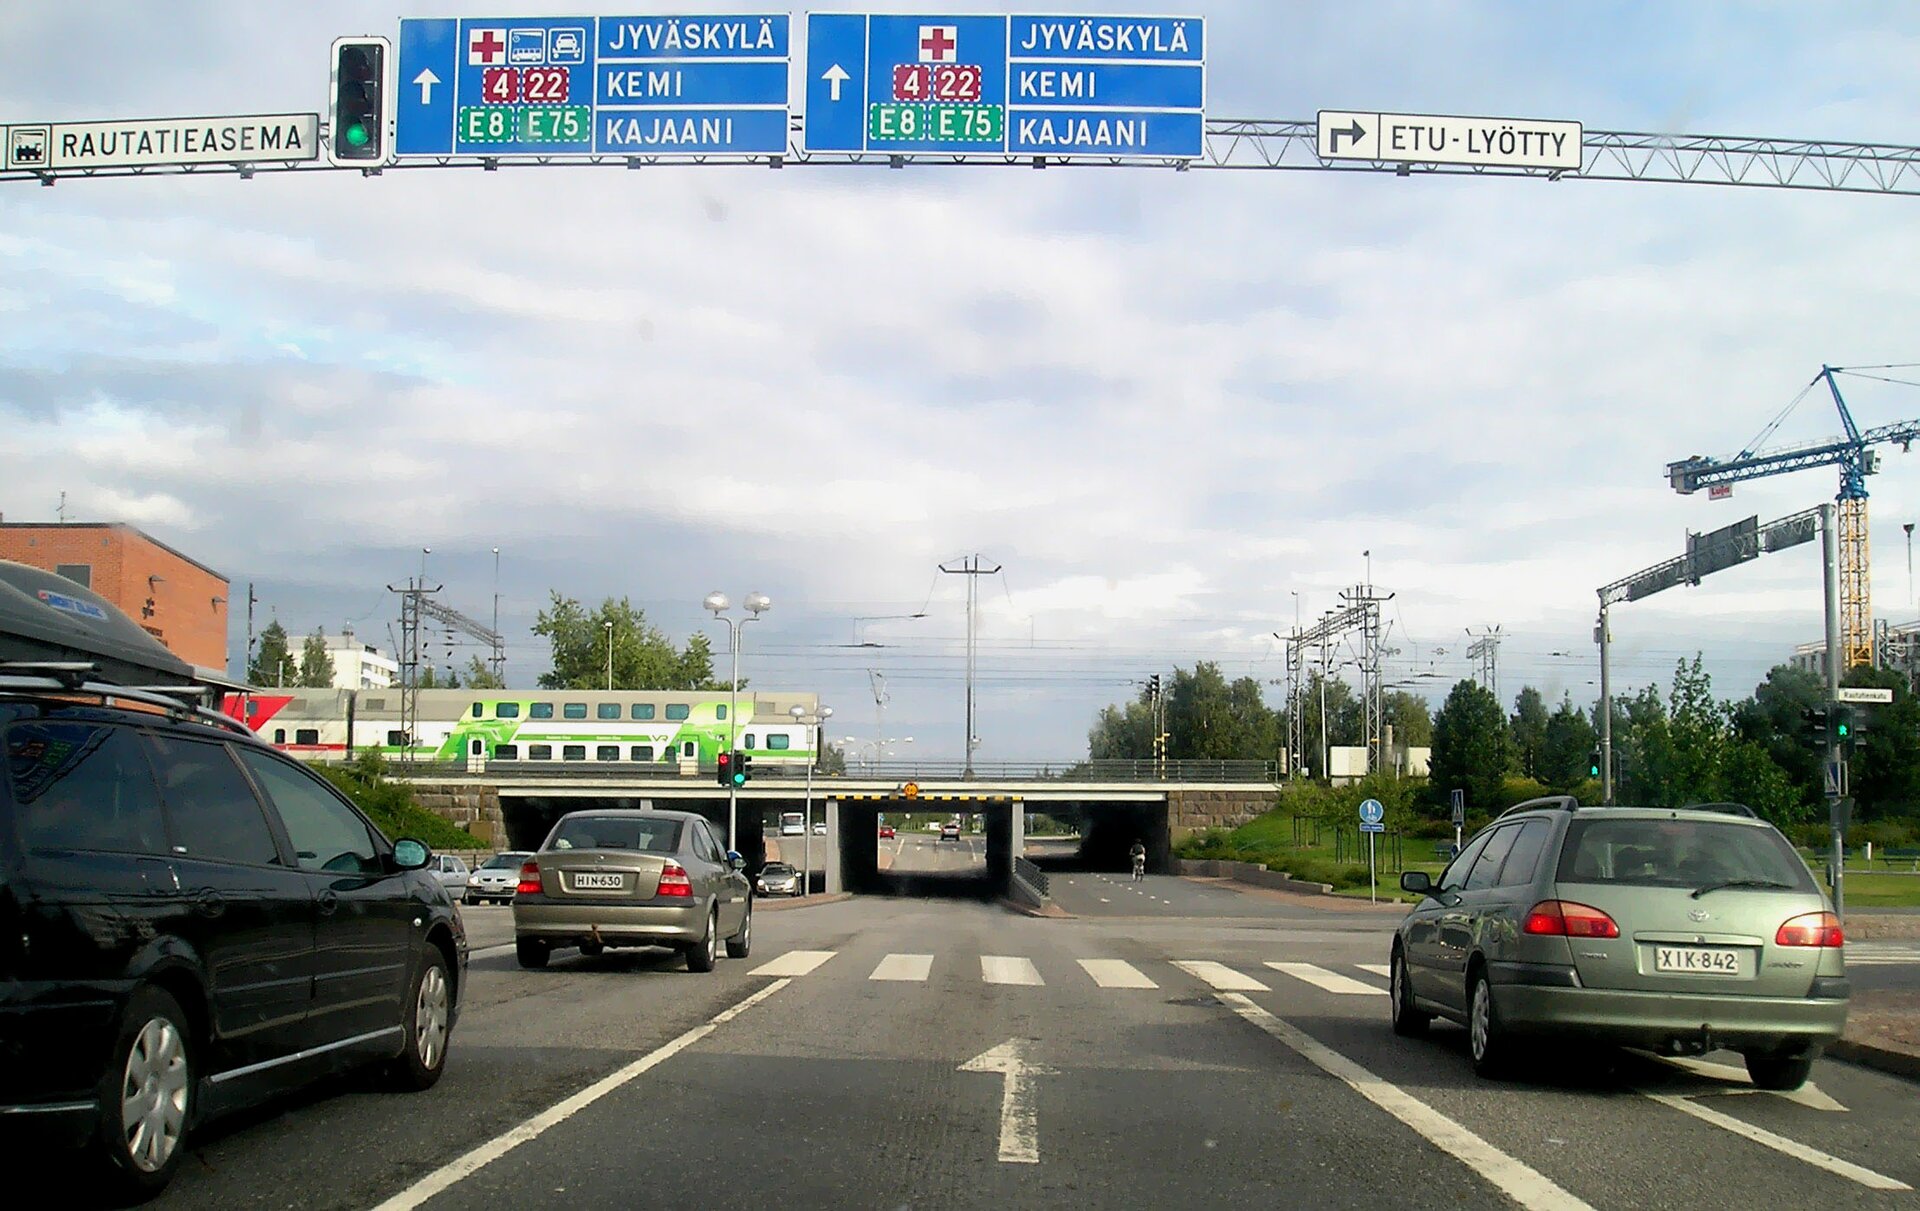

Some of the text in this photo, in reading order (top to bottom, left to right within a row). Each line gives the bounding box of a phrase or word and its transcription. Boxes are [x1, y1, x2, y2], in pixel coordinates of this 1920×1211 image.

[609, 18, 775, 50] JYVÄSKYLÄ
[1021, 19, 1189, 53] JYVÄSKYLÄ
[492, 72, 563, 99] 4 22
[607, 71, 682, 97] KEMI
[903, 70, 975, 97] 4 22
[1020, 70, 1096, 98] KEMI
[469, 111, 504, 138] E8
[606, 118, 733, 145] KAJAANI
[880, 108, 916, 135] E8
[1019, 118, 1147, 147] KAJAANI
[62, 125, 303, 158] RAUTATIEASEMA
[1392, 125, 1567, 157] ETU-LYÖTTY
[577, 876, 621, 887] HIN-630
[1662, 950, 1736, 970] XIK-842
